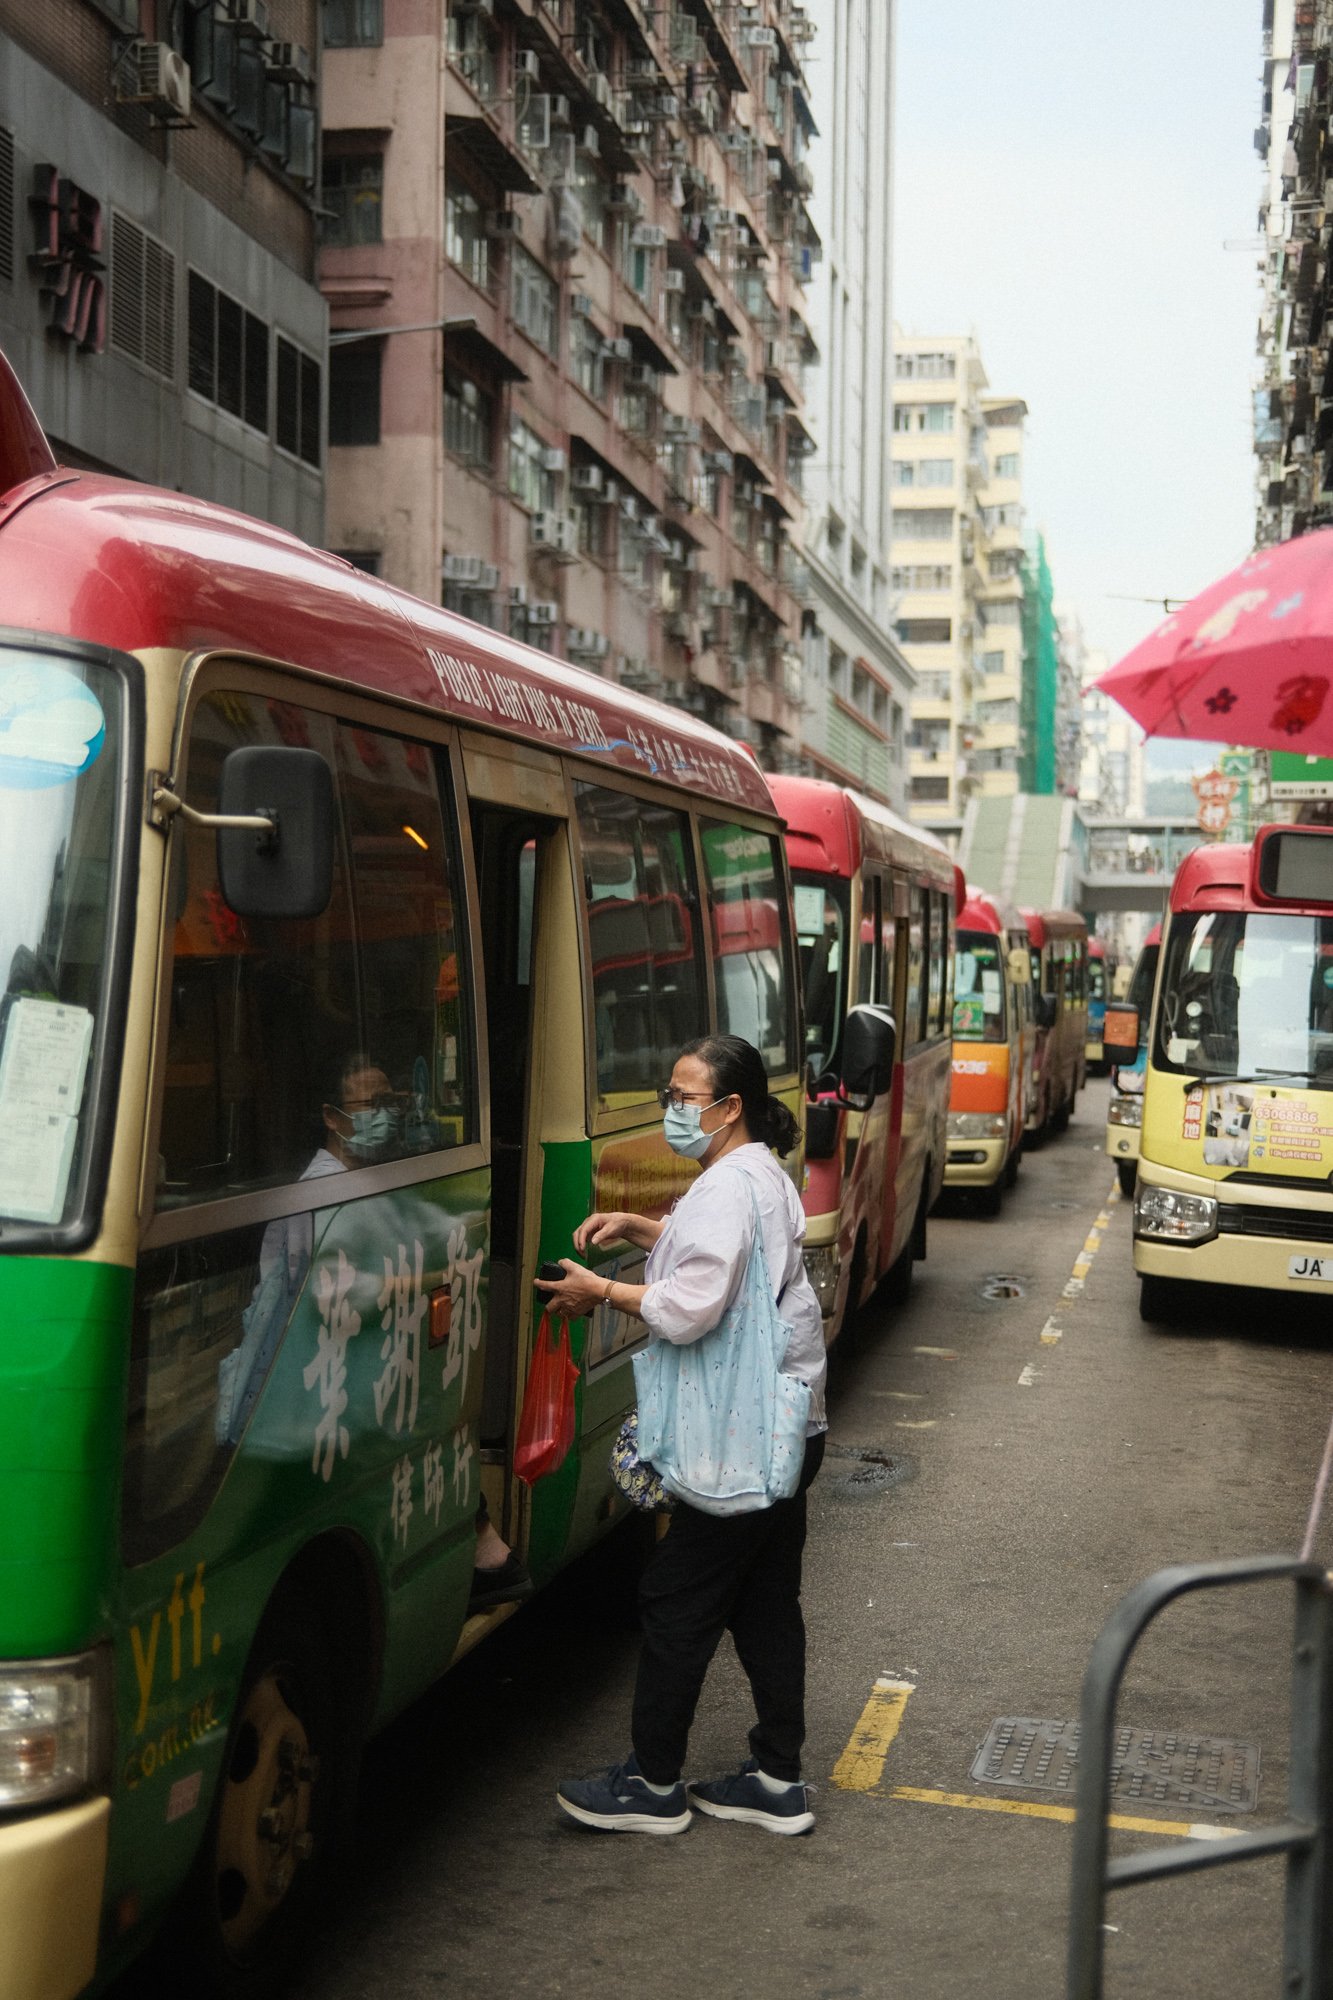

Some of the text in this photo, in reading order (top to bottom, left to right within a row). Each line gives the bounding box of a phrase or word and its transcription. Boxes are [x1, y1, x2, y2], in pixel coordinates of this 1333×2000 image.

[426, 647, 608, 747] PUBLIC LIGHT BUS 16 SEATS
[1294, 1258, 1322, 1277] JA
[391, 1423, 473, 1550] 律師行
